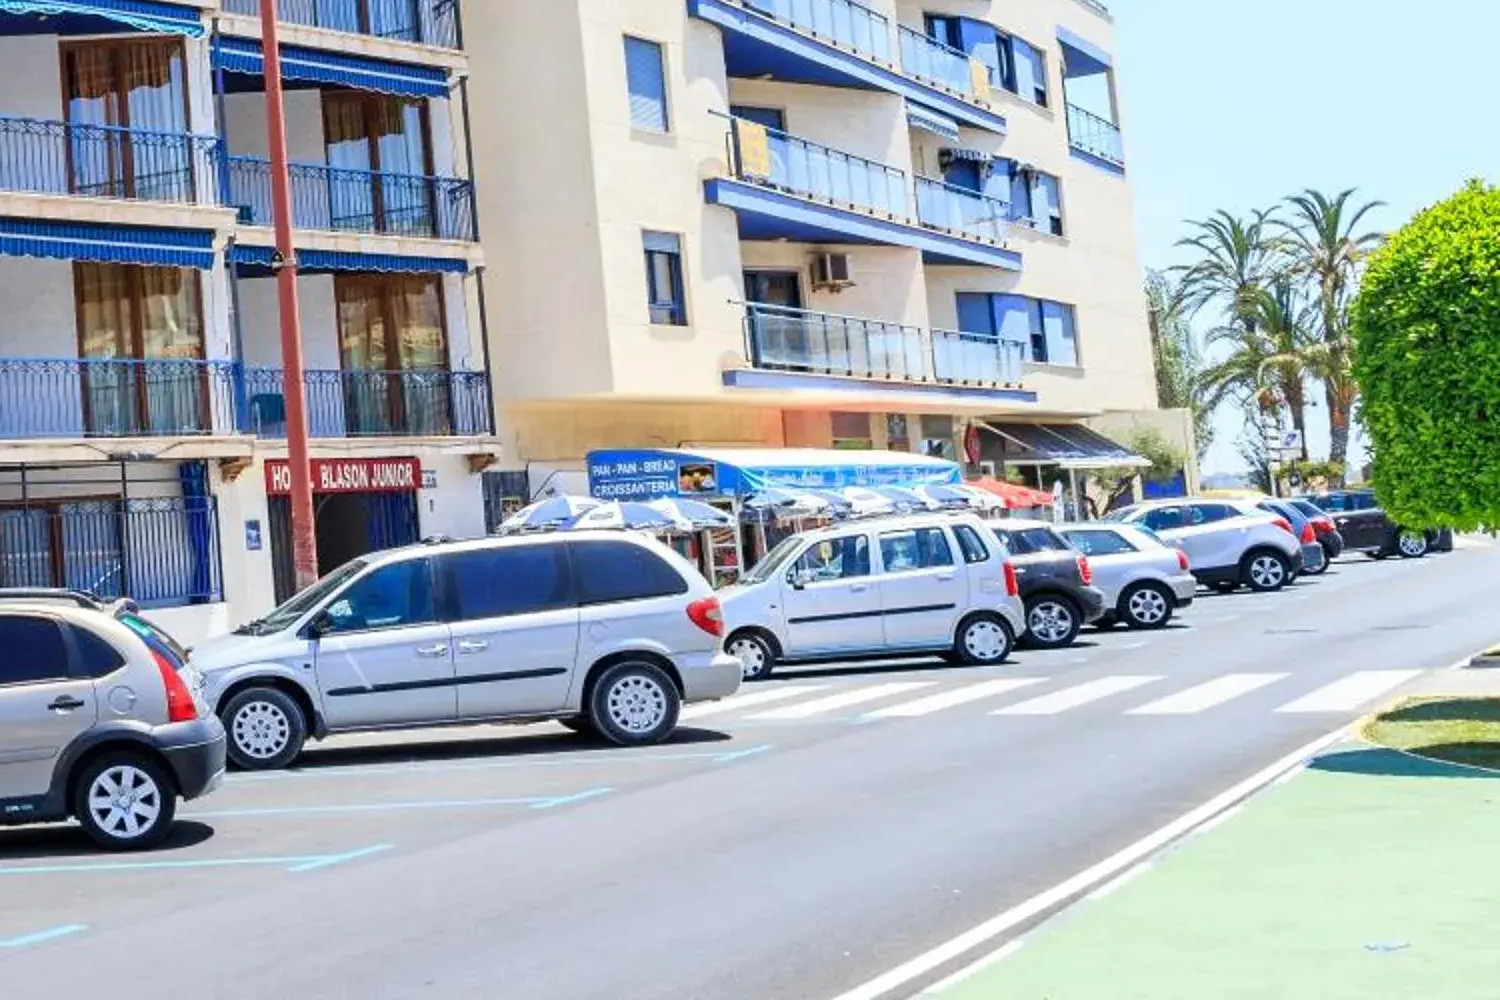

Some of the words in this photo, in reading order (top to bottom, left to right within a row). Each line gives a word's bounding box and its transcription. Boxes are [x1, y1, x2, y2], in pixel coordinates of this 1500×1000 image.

[321, 464, 368, 488] BLASON
[372, 463, 412, 487] JUNIOR
[592, 465, 611, 476] PAN
[644, 459, 676, 473] BREAD
[594, 481, 677, 497] CROISSANTERIA
